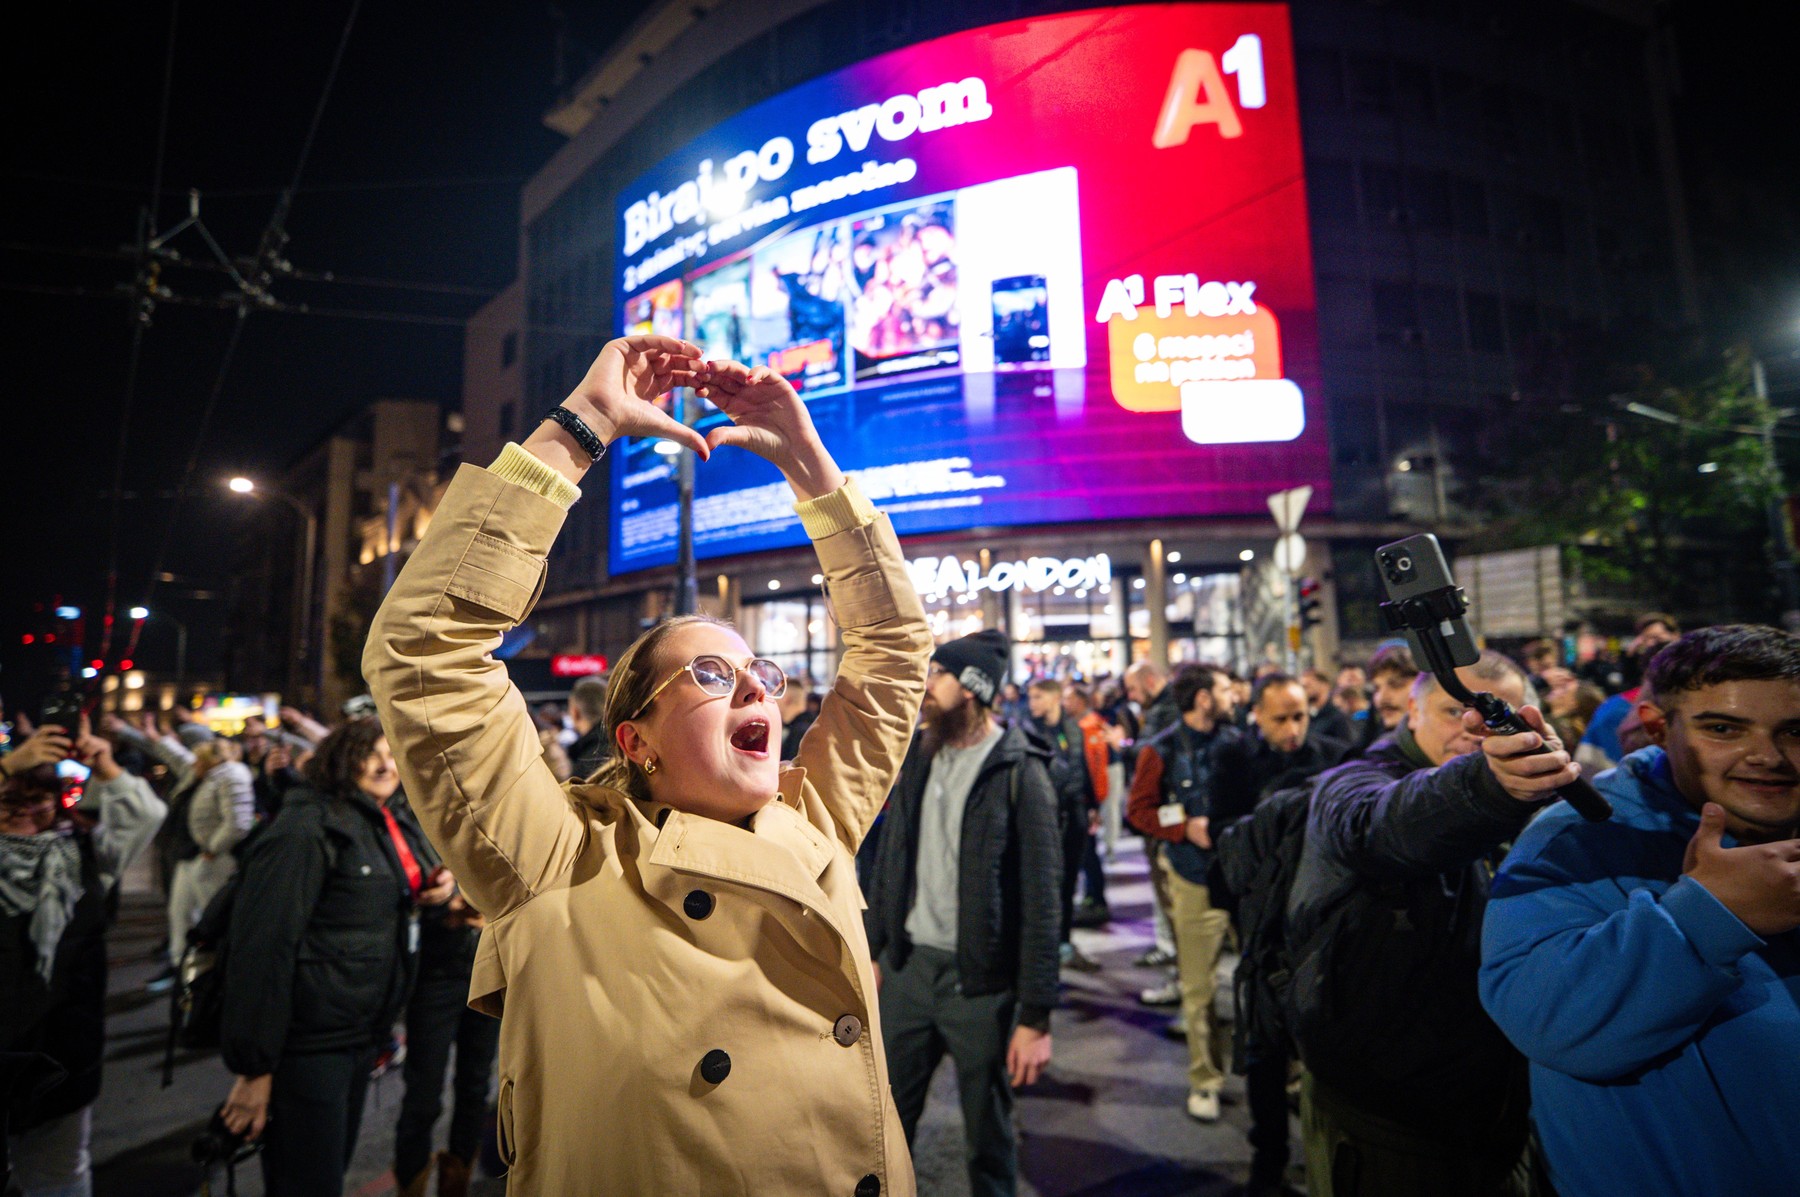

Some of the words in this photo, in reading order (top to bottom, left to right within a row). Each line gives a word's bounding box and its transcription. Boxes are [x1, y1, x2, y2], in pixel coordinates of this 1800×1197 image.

[806, 77, 993, 165] svom
[1152, 33, 1267, 149] A1
[1153, 272, 1258, 318] Flex
[904, 555, 968, 598] EA
[963, 553, 1112, 593] LONDON
